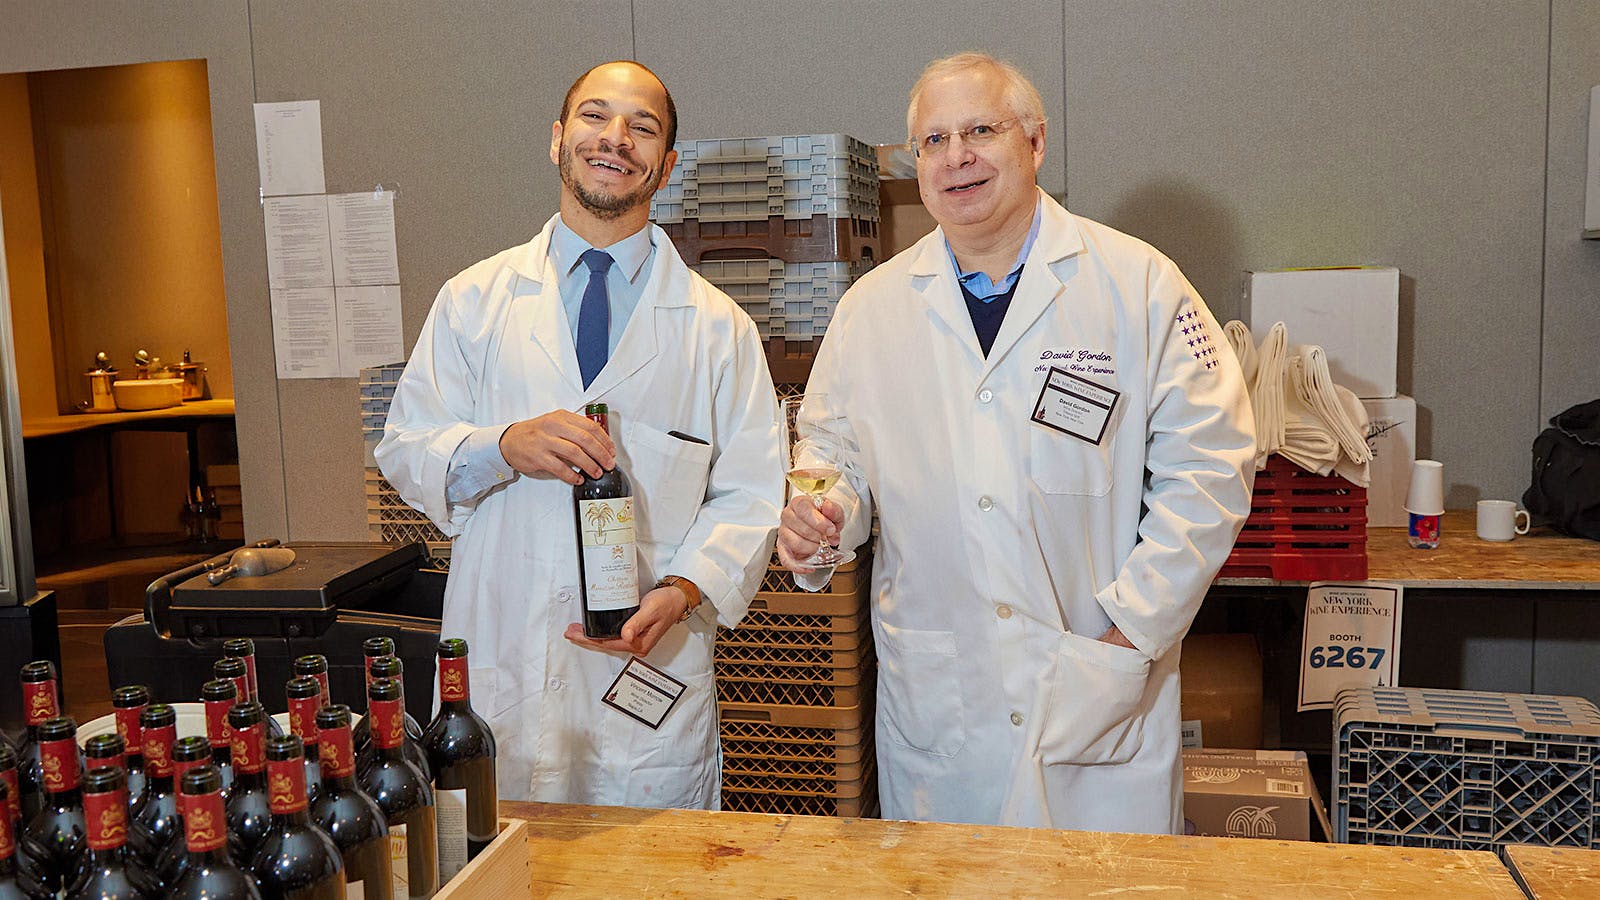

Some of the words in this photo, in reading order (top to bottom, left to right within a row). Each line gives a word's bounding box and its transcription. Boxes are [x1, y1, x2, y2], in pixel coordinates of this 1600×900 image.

[1040, 350, 1074, 360] David
[1076, 350, 1112, 362] Gordon
[1070, 364, 1086, 372] Wine
[1087, 364, 1115, 375] Experience
[1059, 398, 1073, 407] David
[1072, 403, 1091, 414] Gordon
[1323, 596, 1344, 604] NEW
[1347, 596, 1373, 606] YORK
[1331, 606, 1392, 617] EXPERIENCE
[1329, 634, 1361, 642] BOOTH
[1309, 645, 1386, 670] 6267
[630, 682, 647, 694] Vincent
